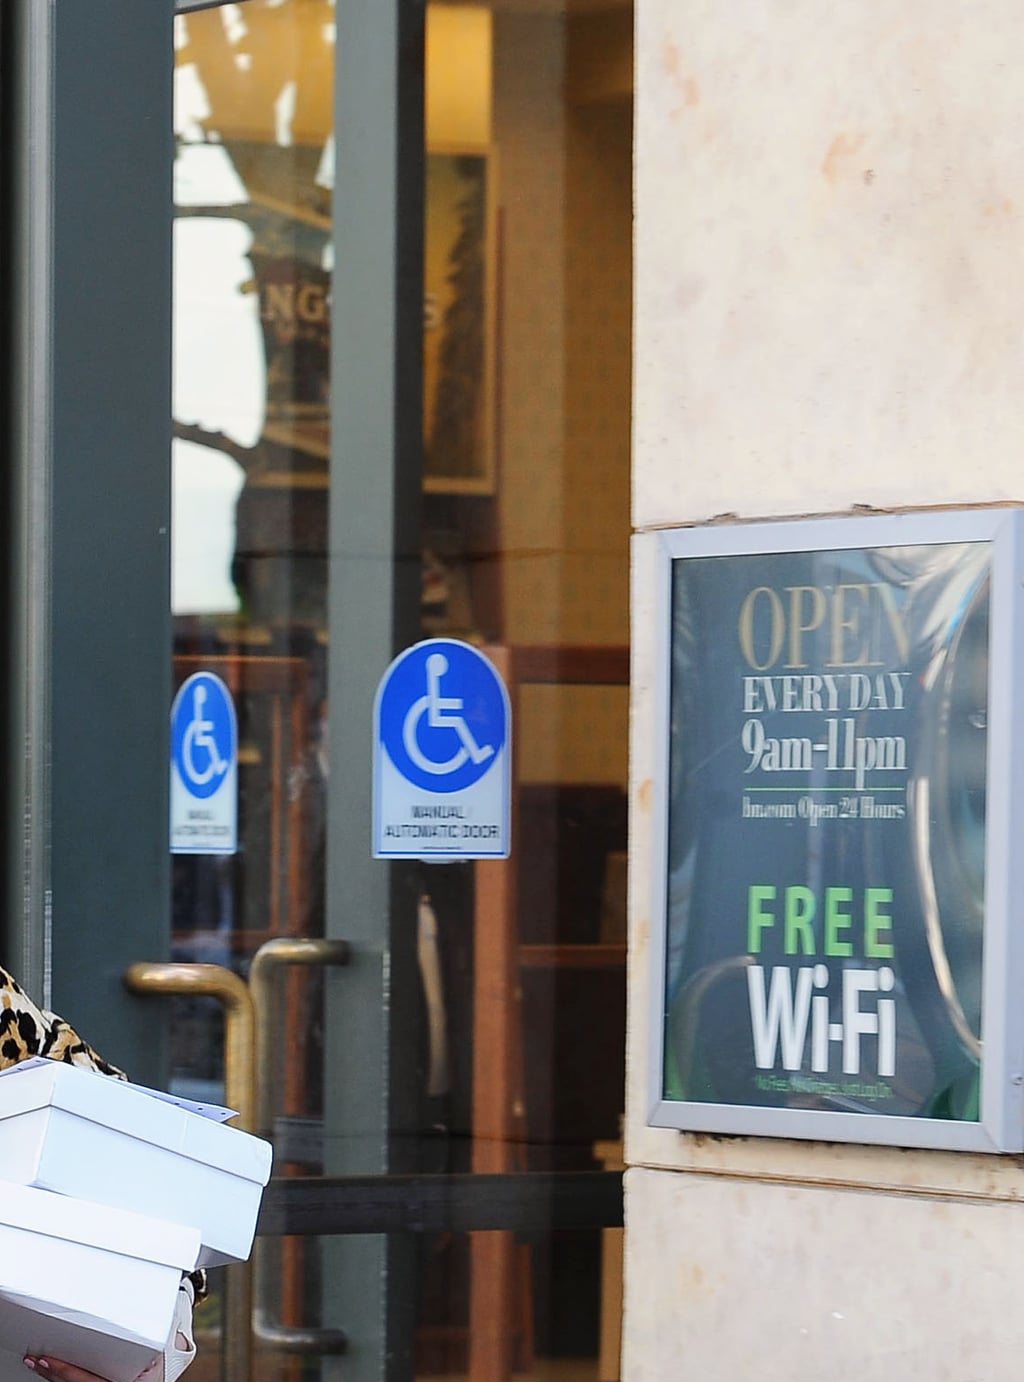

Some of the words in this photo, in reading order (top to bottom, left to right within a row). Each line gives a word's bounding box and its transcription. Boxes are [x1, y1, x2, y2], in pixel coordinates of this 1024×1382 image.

[739, 582, 913, 671] OPEN
[742, 718, 909, 791] 9am-11pm
[798, 796, 838, 827] Open
[860, 796, 906, 819] Hours
[747, 884, 895, 958] FREE
[747, 964, 896, 1077] Wi-Fi
